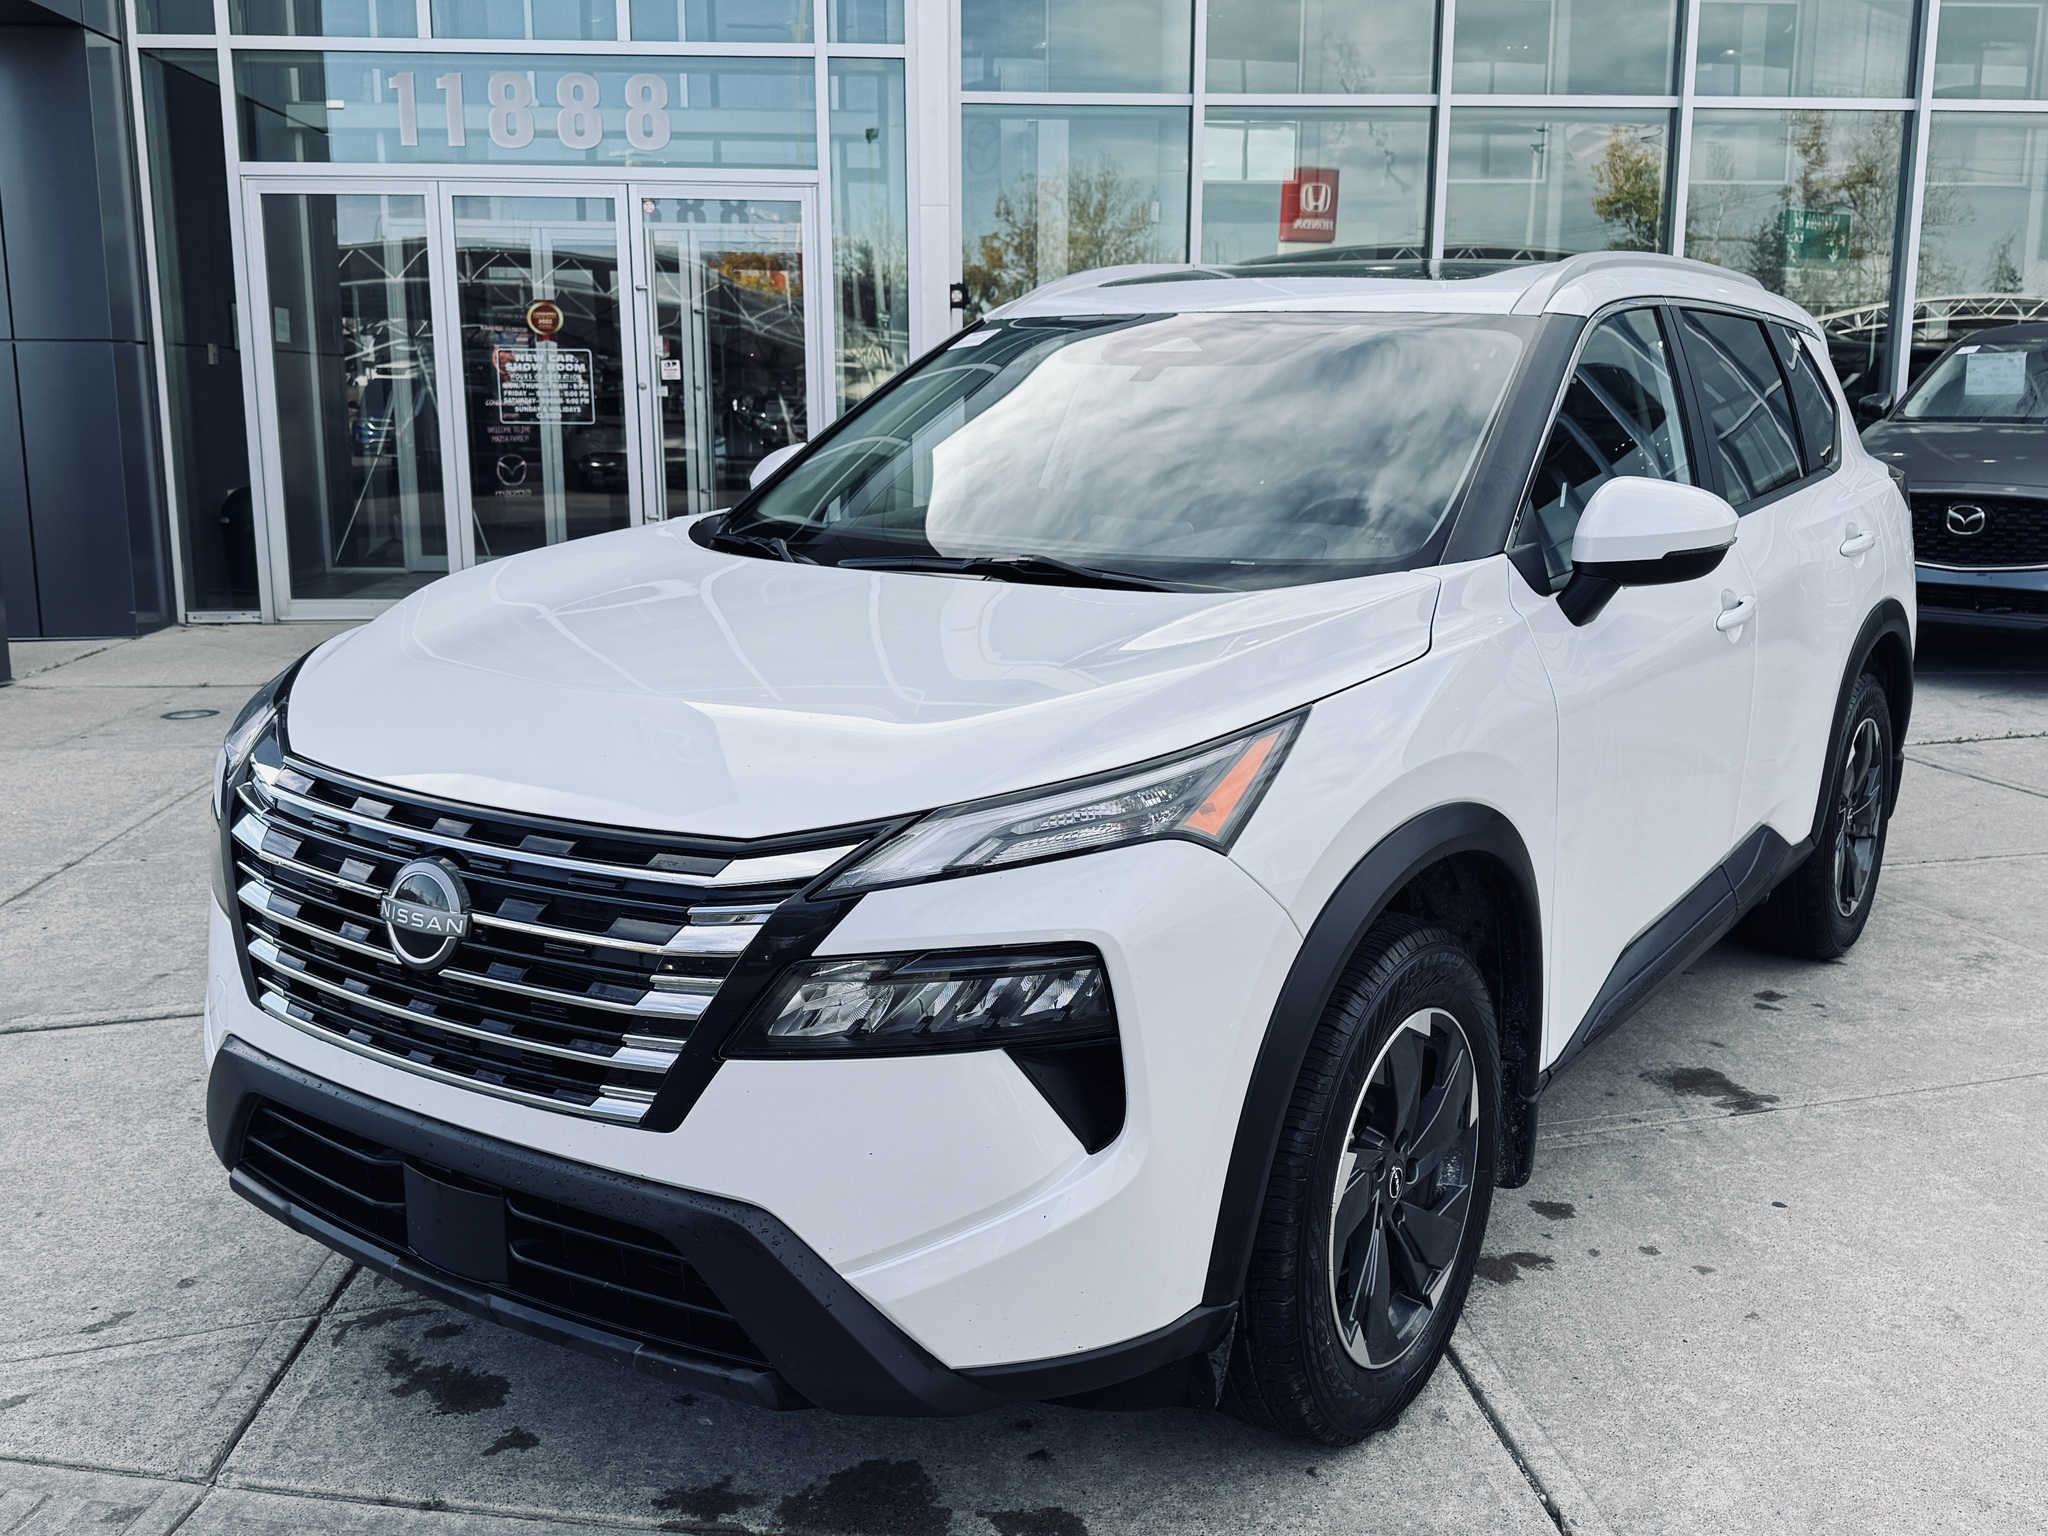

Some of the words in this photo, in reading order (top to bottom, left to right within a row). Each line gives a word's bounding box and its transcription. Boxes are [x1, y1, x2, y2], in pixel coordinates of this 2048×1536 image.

[388, 71, 671, 150] 11888
[514, 353, 544, 362] NEW
[505, 362, 543, 371] SHOW
[547, 363, 586, 372] ROOM
[487, 426, 512, 434] WELCOME
[381, 900, 464, 934] NISSAN
